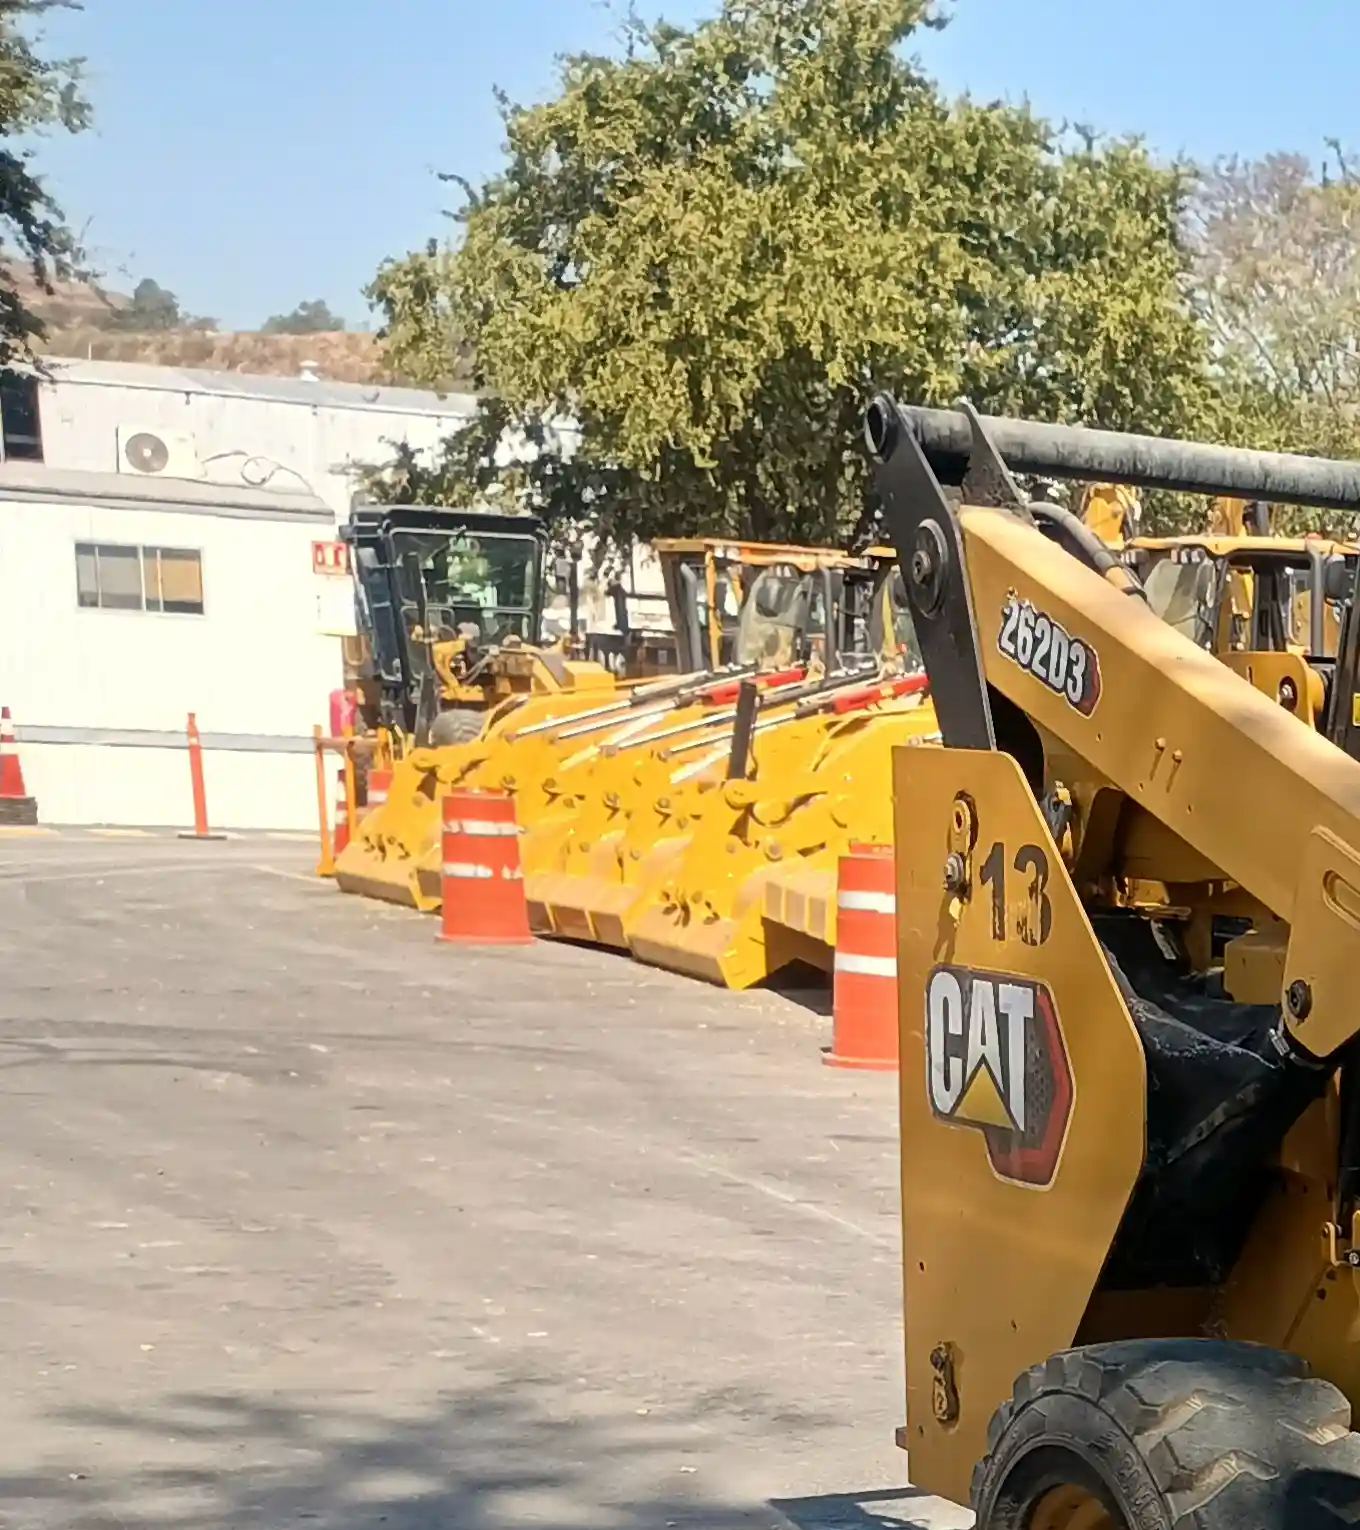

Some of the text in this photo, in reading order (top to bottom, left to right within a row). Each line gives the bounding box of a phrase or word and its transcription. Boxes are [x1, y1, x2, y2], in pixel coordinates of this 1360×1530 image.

[1000, 599, 1087, 703] 262D3
[979, 841, 1053, 947] 13
[929, 970, 1035, 1132] CAT
